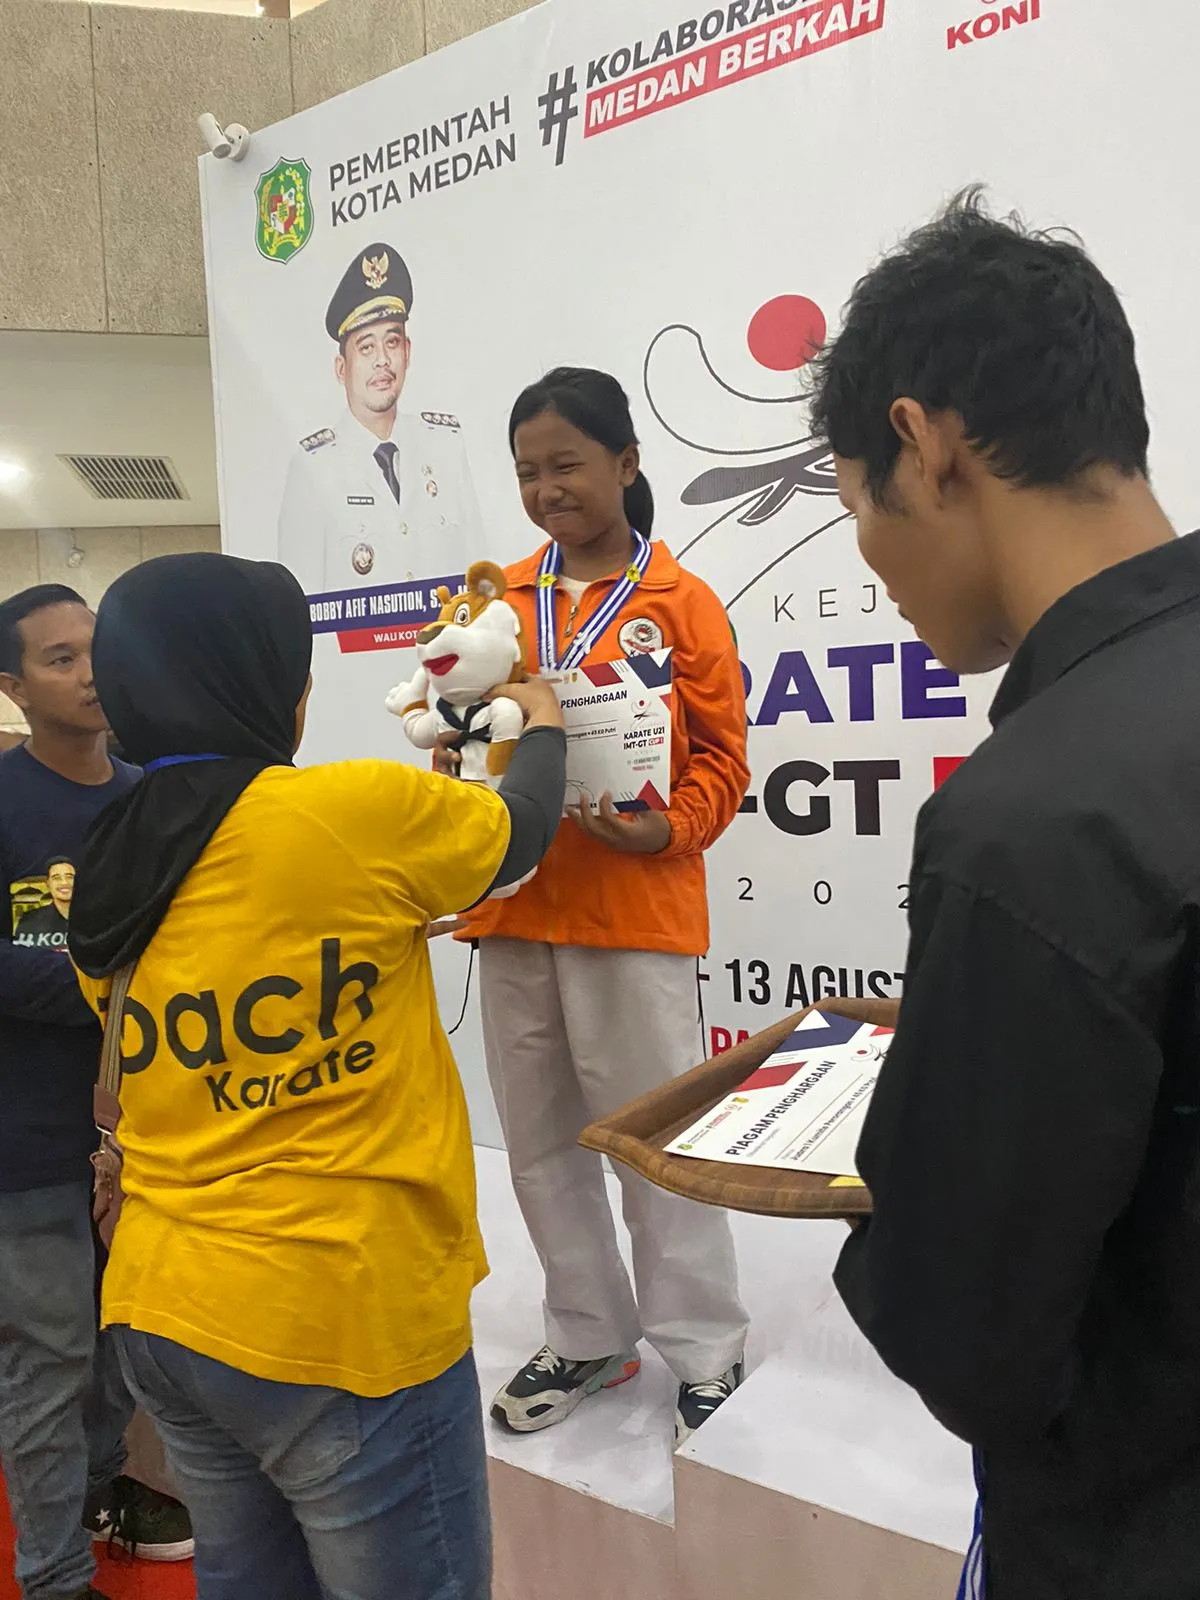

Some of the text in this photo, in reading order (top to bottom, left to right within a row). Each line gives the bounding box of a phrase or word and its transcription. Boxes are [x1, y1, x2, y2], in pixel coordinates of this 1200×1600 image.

[947, 0, 1041, 49] KONI
[589, 0, 878, 128] MEDAN BERKAH
[329, 95, 510, 191] PEMERINTAH
[331, 133, 516, 227] KOTA MEDAN
[309, 600, 343, 622] BOBBY
[345, 596, 367, 618] AFIF
[369, 590, 427, 615] NASUTION,
[560, 690, 628, 709] PENGHARGAAN
[738, 640, 967, 726] ATE
[623, 729, 651, 740] KARATE
[653, 726, 665, 735] U21
[623, 739, 647, 750] IMT-GT
[725, 958, 771, 1005] 13
[204, 1040, 376, 1113] Karate
[724, 1119, 775, 1156] PIAGAM
[765, 1060, 837, 1119] PENGHARGAAN
